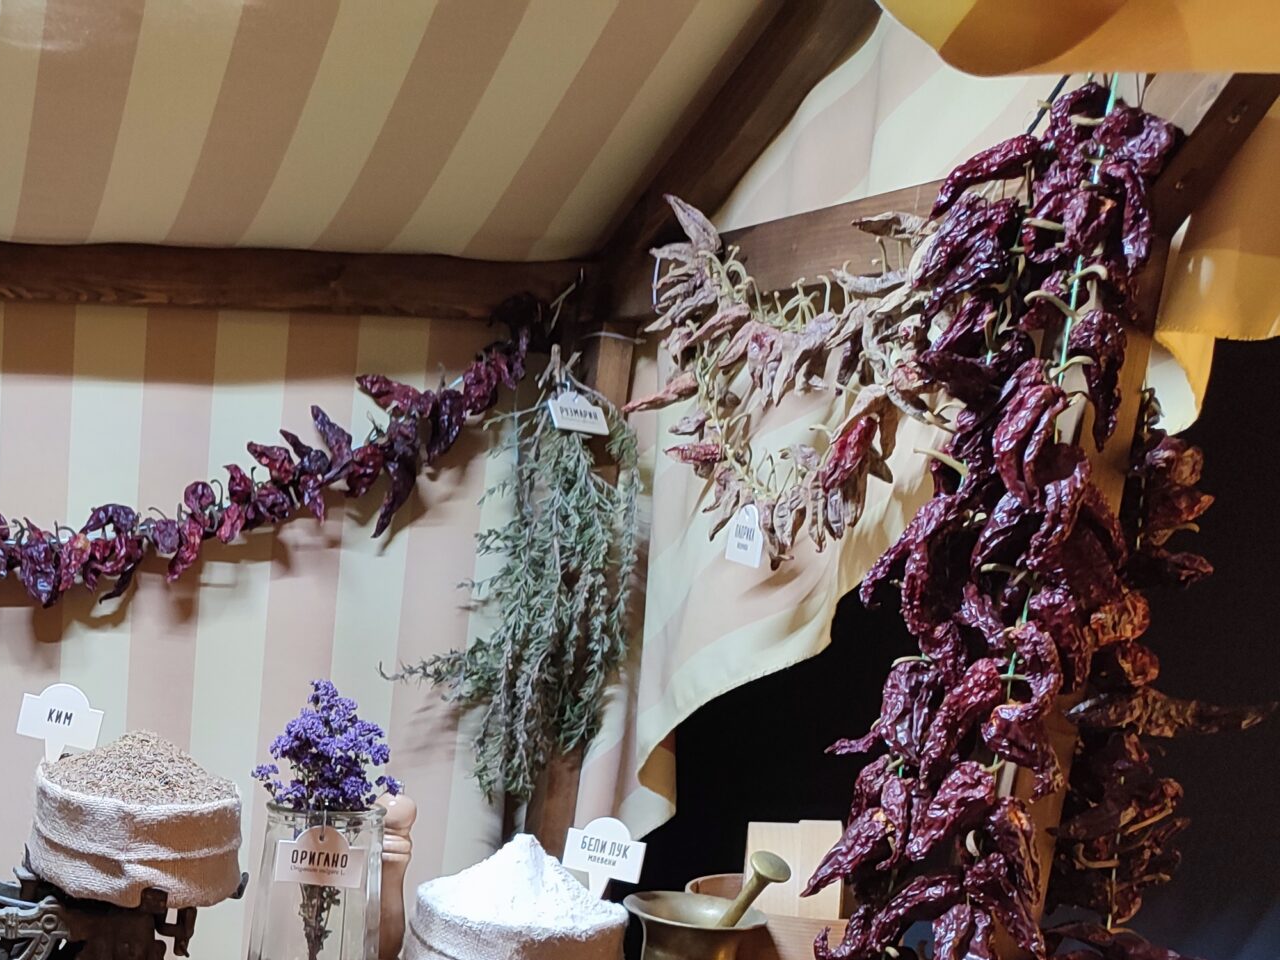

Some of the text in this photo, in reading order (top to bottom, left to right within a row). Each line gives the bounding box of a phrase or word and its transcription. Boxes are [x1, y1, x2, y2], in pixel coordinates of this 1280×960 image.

[46, 707, 74, 727] КИМ
[580, 834, 631, 860] БЕЛИ ЛУК
[290, 848, 349, 869] ОРИГАНО
[587, 854, 617, 867] млевени
